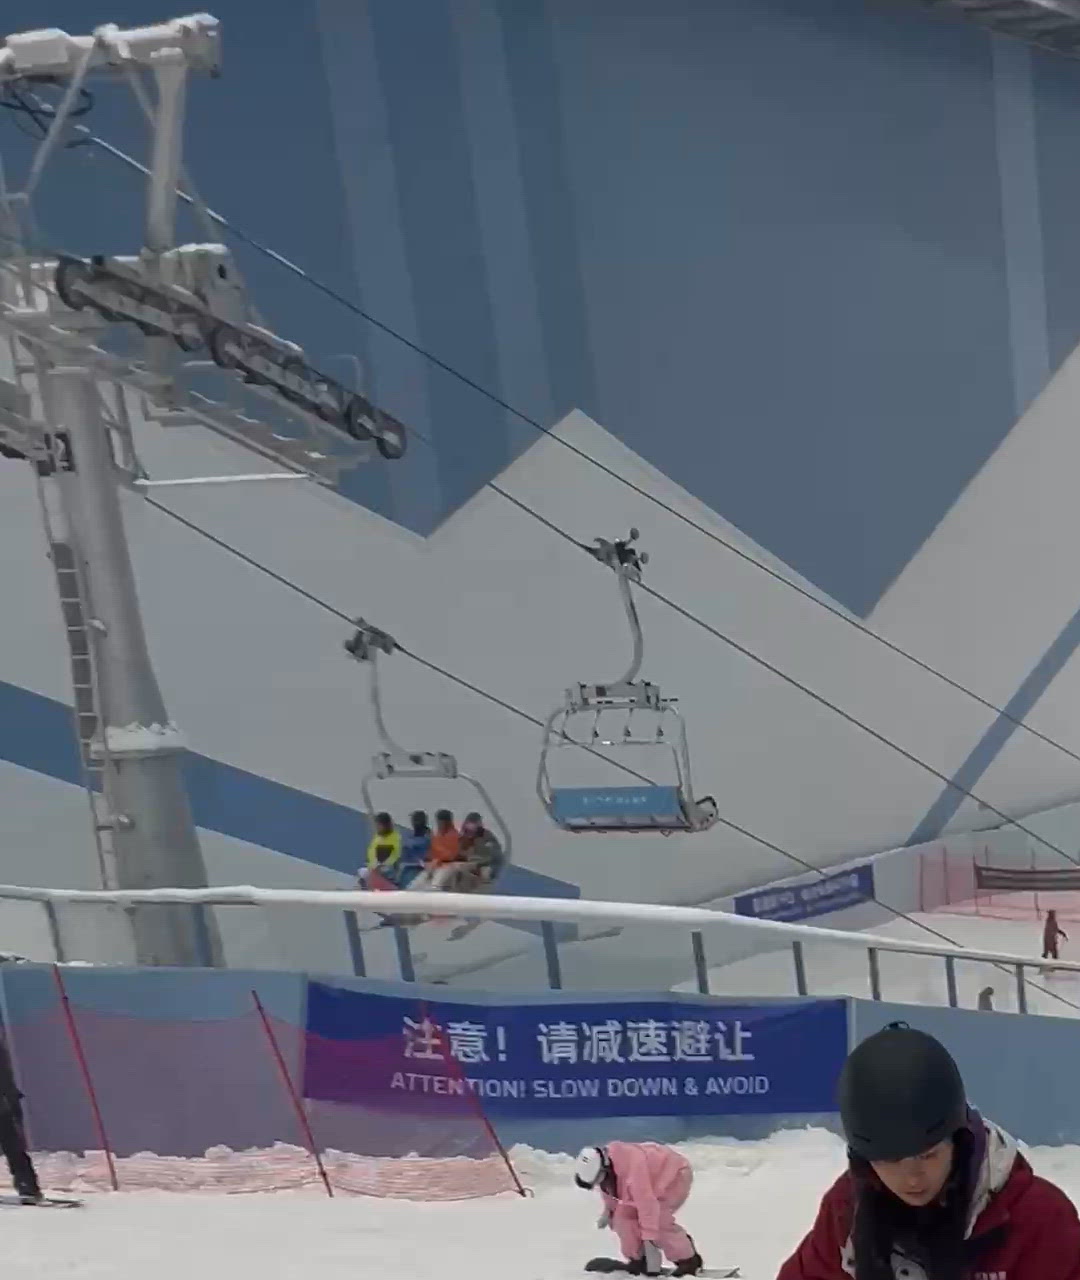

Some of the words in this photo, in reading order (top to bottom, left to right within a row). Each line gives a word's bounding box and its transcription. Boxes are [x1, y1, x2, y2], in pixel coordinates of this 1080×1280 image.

[390, 1072, 526, 1098] ATTENTION!
[533, 1078, 600, 1098] SLOW
[607, 1077, 677, 1098] DOWN
[684, 1076, 699, 1096] &
[705, 1076, 770, 1096] AVOID
